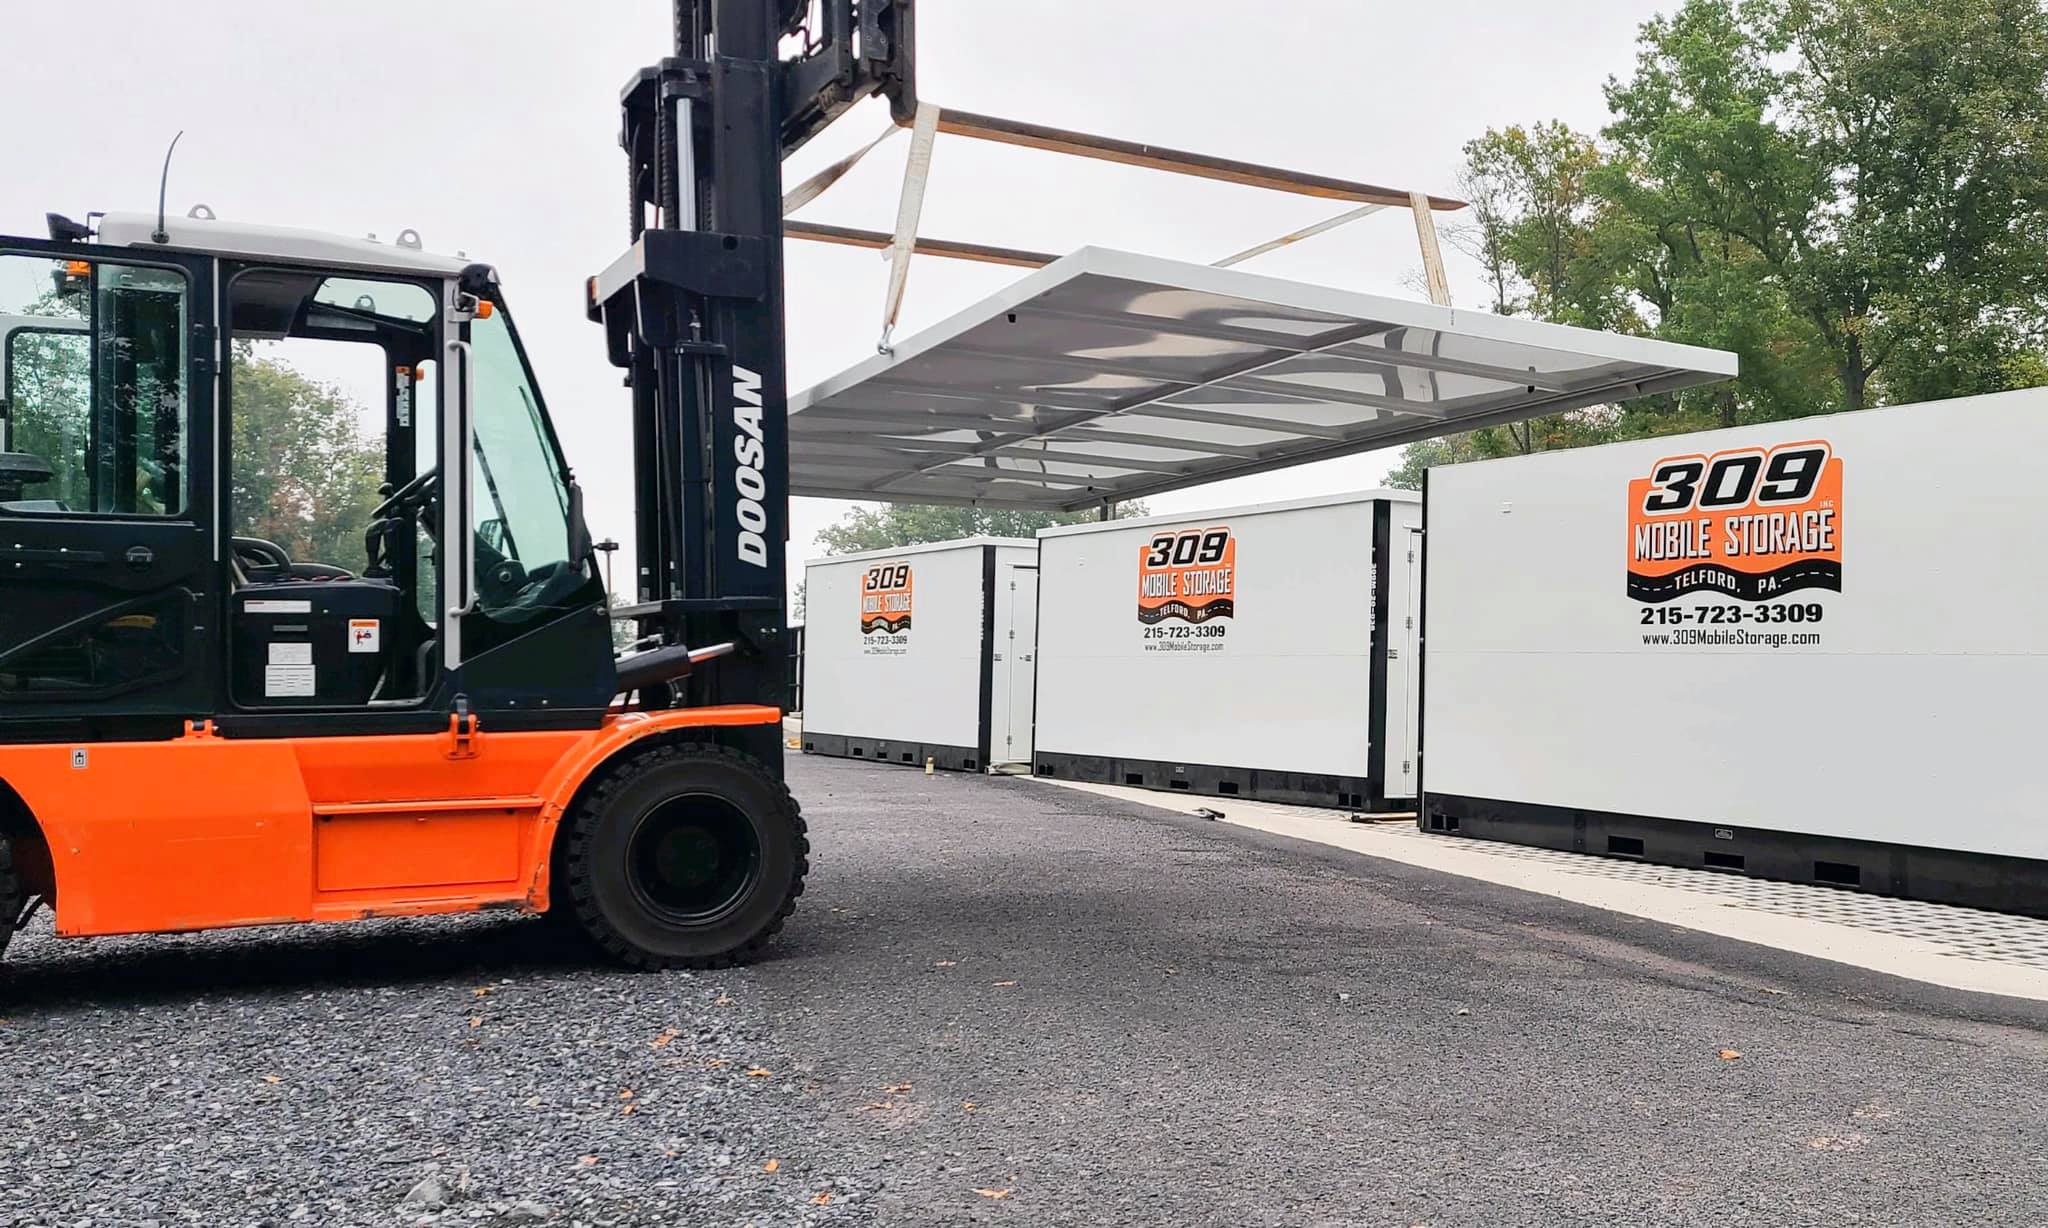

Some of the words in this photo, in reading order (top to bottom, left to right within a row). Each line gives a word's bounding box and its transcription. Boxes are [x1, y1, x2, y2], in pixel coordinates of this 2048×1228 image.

[732, 365, 767, 568] DOOSAN
[1645, 449, 1825, 511] 309
[1635, 519, 1712, 561] MOBILE
[1724, 509, 1835, 556] STORAGE
[1148, 532, 1228, 567] 309
[866, 565, 909, 590] 309
[1142, 572, 1178, 598] MOBILE
[1183, 569, 1231, 596] STORAGE
[1675, 569, 1741, 593] TELFORD,
[1758, 576, 1782, 593] PA.
[1640, 603, 1823, 625] 215-723-3309
[1144, 625, 1225, 638] 215-723-3309
[1642, 629, 1820, 648] www.309MobileStorage.com
